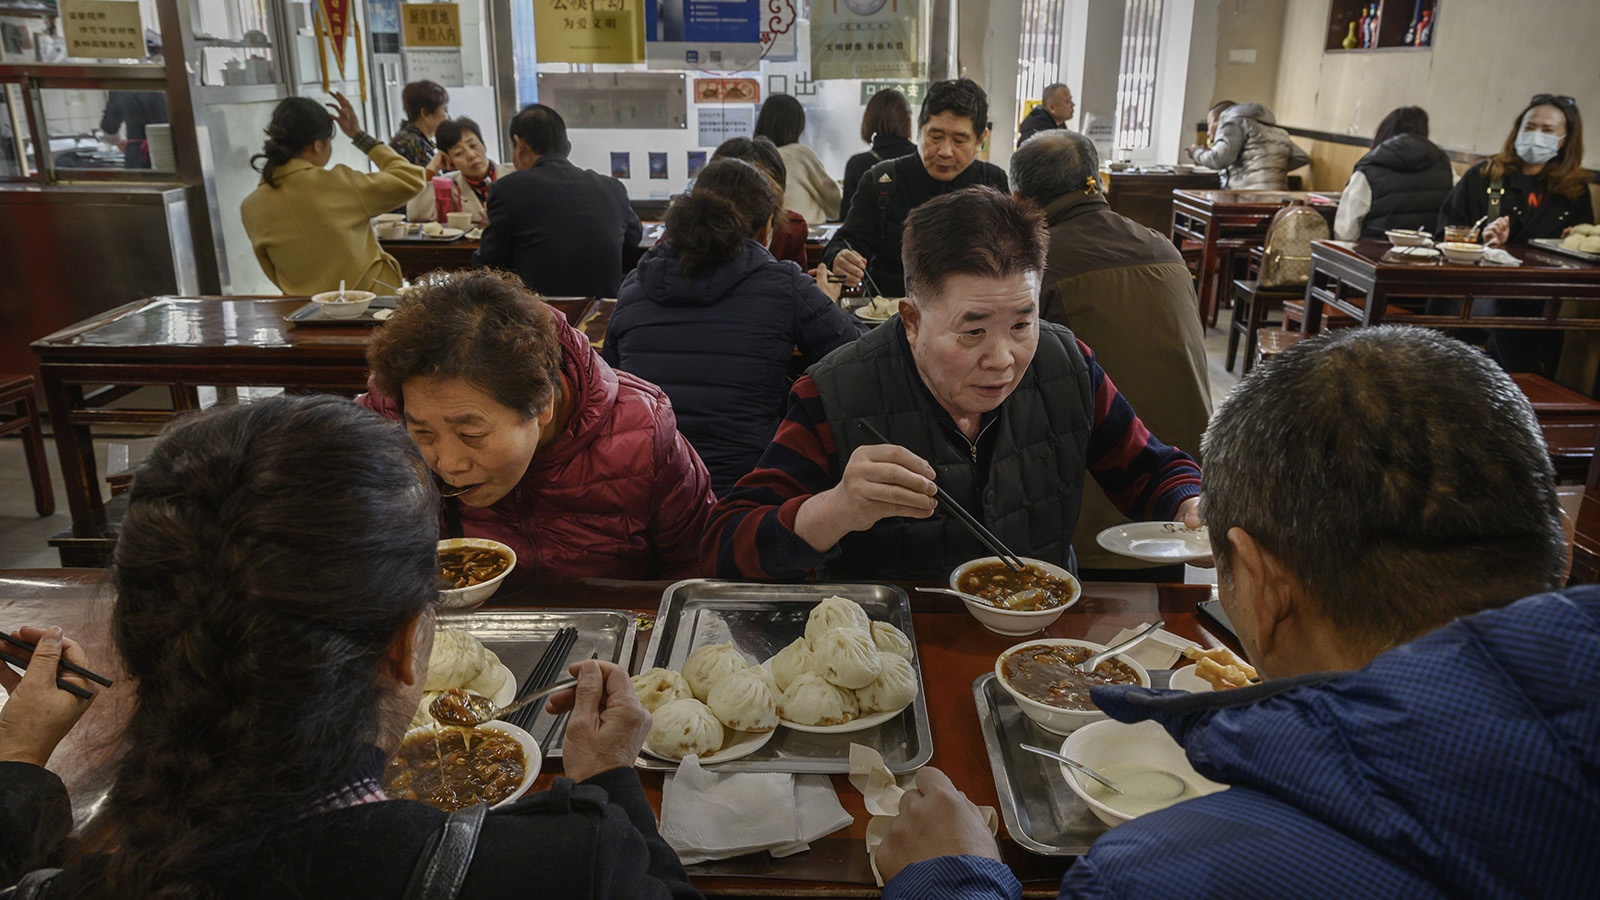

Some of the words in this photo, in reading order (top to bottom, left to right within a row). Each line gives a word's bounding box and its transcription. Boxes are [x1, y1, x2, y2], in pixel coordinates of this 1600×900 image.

[410, 9, 449, 24] 厨房重地
[563, 17, 616, 29] 为爱文明
[417, 26, 456, 42] 请勿入内
